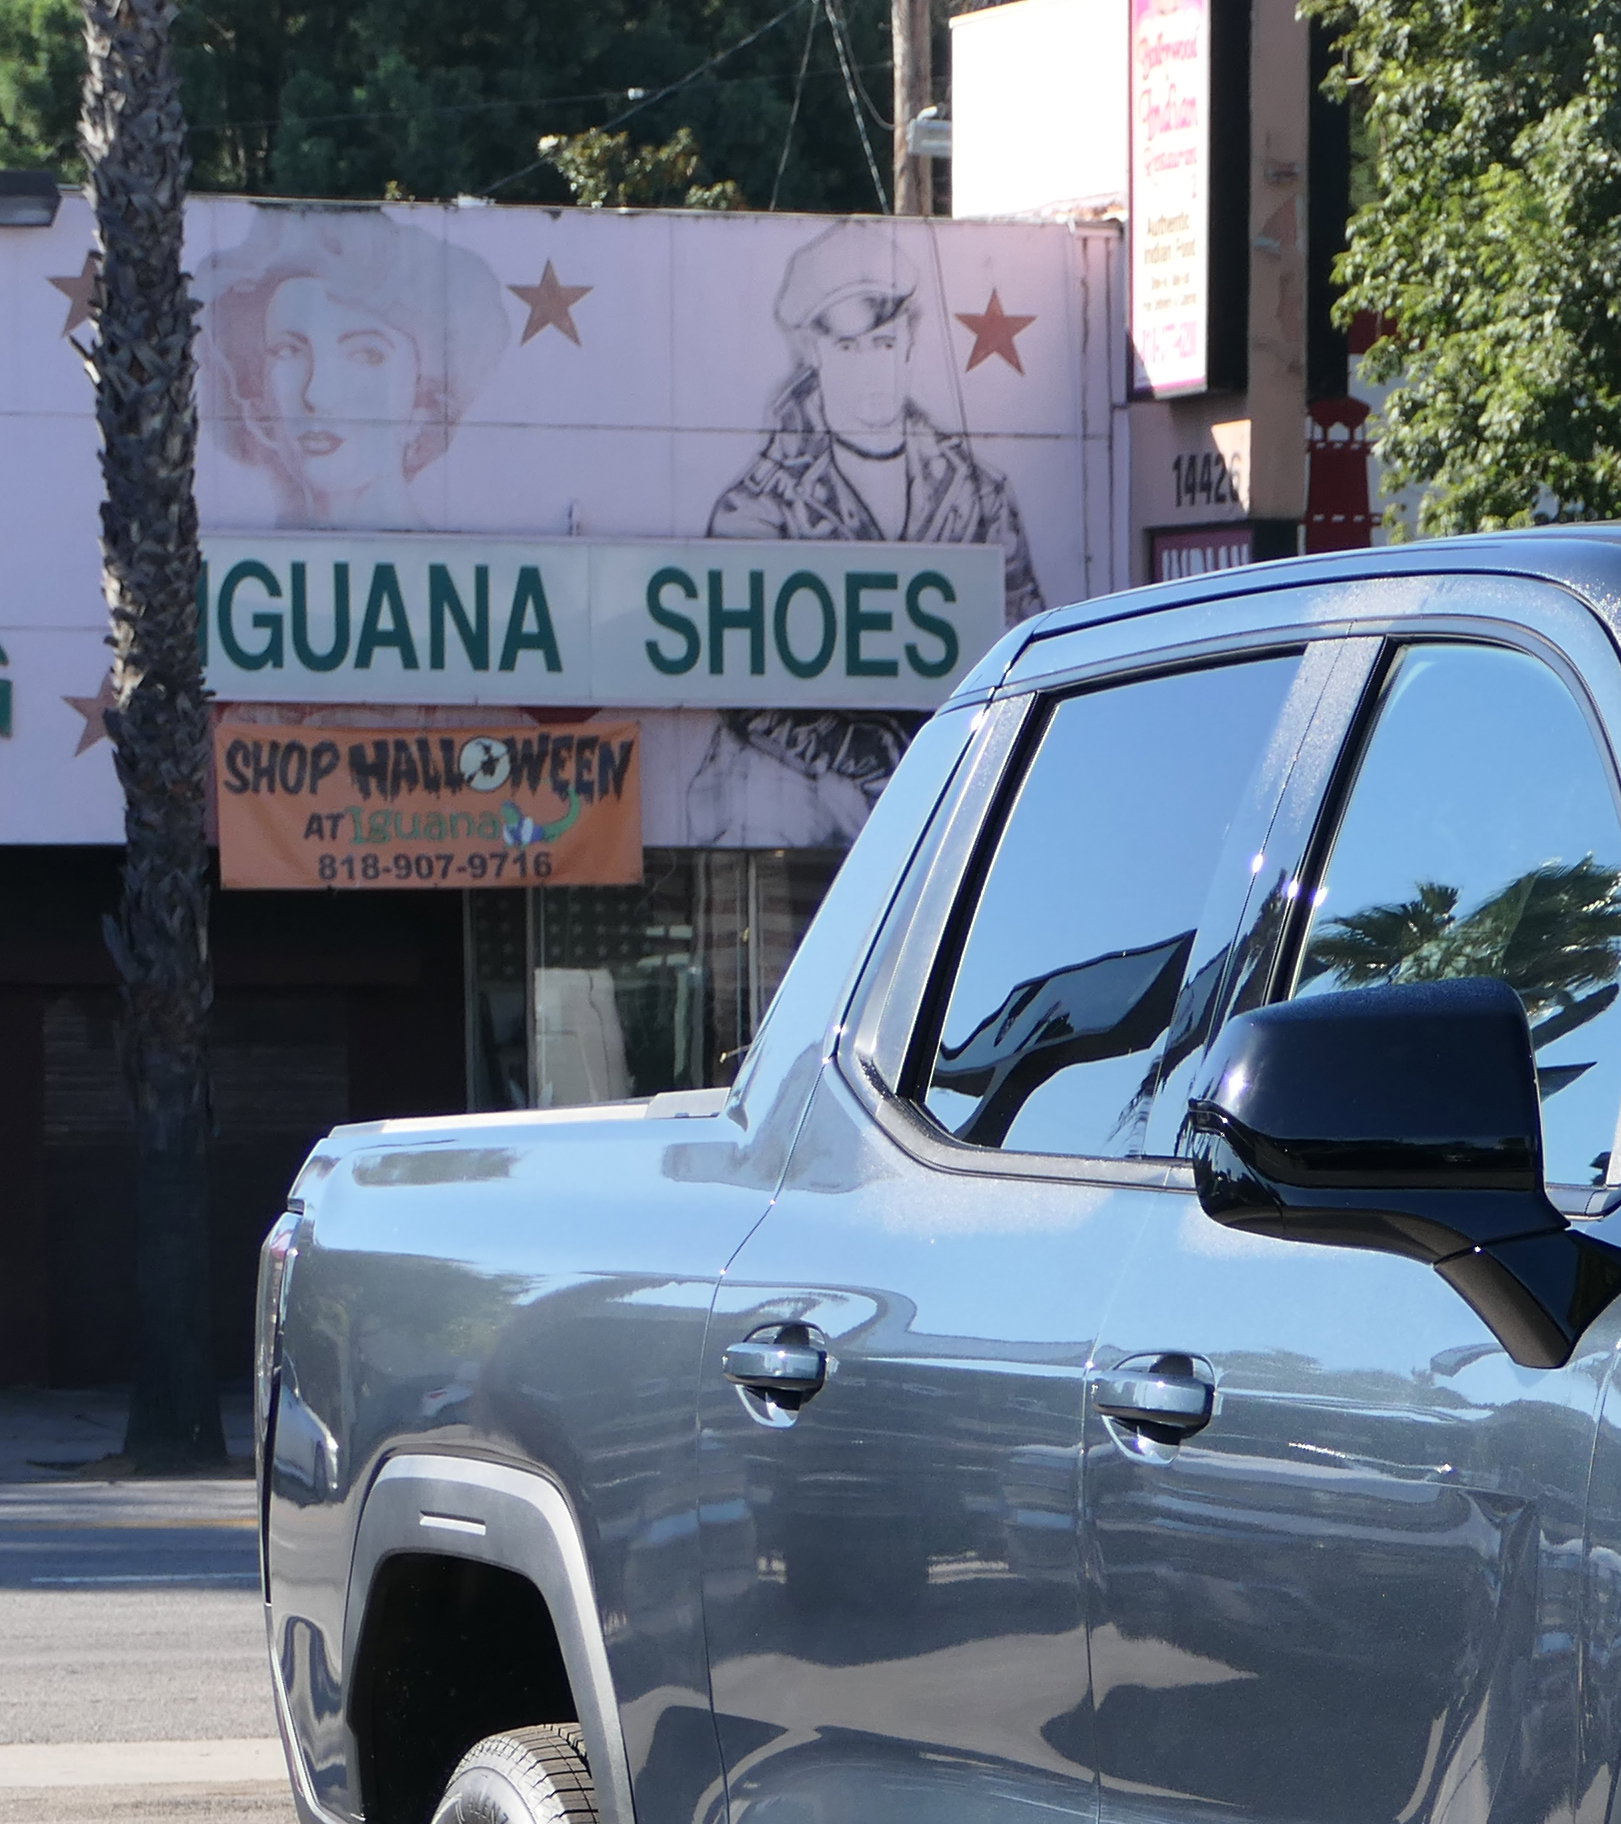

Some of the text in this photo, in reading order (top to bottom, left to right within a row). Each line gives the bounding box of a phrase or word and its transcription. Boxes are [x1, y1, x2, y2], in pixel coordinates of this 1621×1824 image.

[200, 558, 960, 680] IGUANA SHOES
[224, 731, 635, 803] SHOP HALLOWEEN
[304, 803, 500, 847] AT Iguana
[318, 850, 553, 883] 818-907-9716
